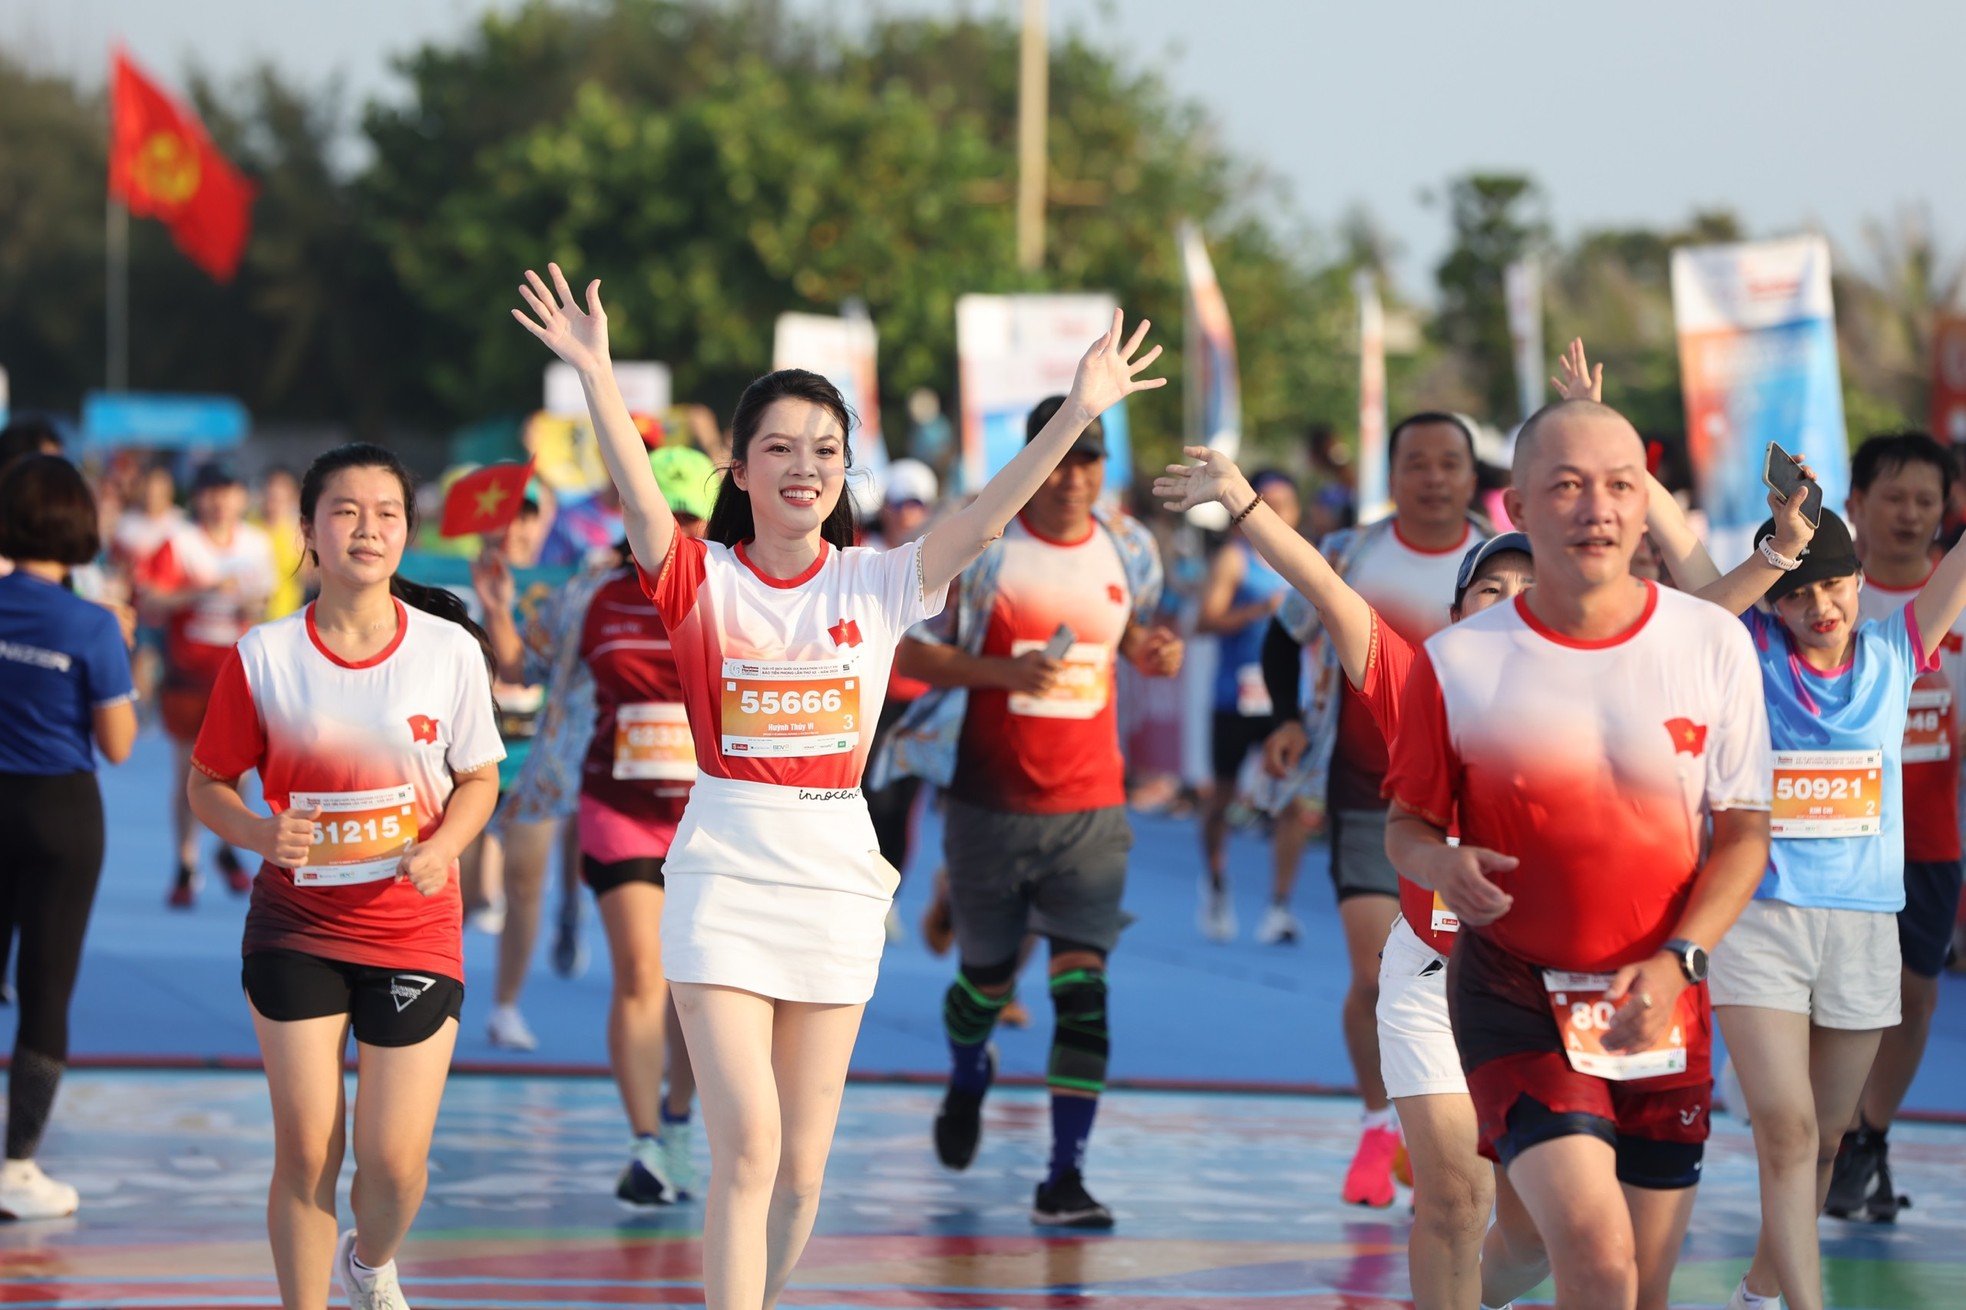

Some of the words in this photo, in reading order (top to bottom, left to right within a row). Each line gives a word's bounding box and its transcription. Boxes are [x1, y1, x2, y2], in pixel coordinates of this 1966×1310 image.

[740, 688, 841, 715] 55666
[843, 714, 854, 730] 3
[1776, 777, 1862, 800] 50921
[1865, 800, 1876, 816] 2
